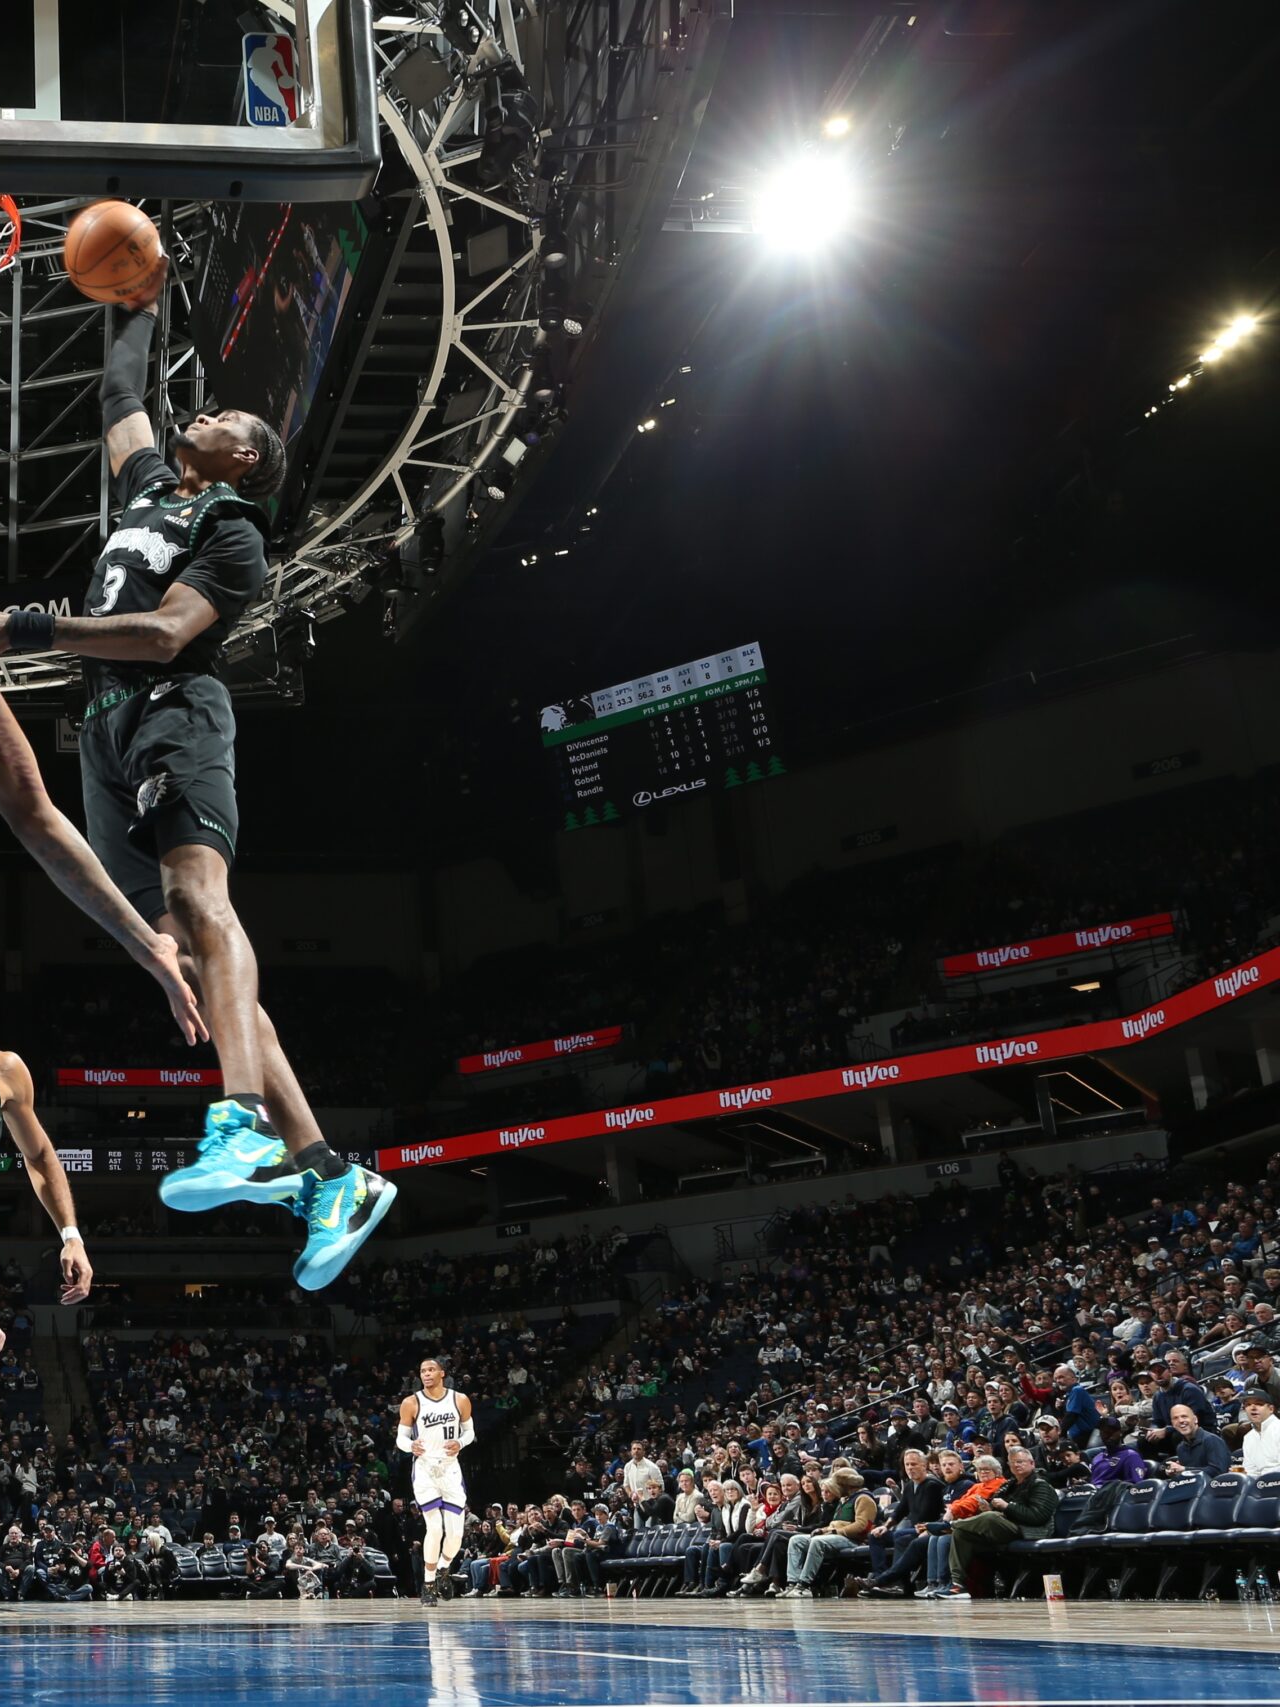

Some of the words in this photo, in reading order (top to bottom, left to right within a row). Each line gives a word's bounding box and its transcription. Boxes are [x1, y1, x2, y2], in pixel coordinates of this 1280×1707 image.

[254, 105, 280, 122] NBA
[163, 514, 189, 528] sezzle
[90, 563, 128, 617] 3
[657, 675, 669, 683] REB
[678, 668, 691, 677] AST
[700, 662, 710, 670] TO
[721, 655, 733, 664] STL
[742, 648, 755, 657] BLK
[598, 702, 613, 713] 41.2
[617, 696, 633, 707] 33.3
[638, 690, 654, 700] 56.2
[661, 685, 672, 694] 26
[682, 678, 692, 687] 14
[643, 707, 655, 716] PTS
[658, 702, 670, 711] REB
[673, 697, 686, 707] AST
[689, 693, 699, 702] PF
[734, 675, 760, 688] 3PM/A
[566, 735, 609, 752] DiVincenzo
[746, 689, 759, 699] 1/5
[569, 746, 609, 763] McDaniels
[748, 701, 762, 711] 1/4
[571, 761, 599, 775] Hyland
[752, 713, 765, 723] 1/3
[574, 773, 601, 786] Gobert
[670, 750, 680, 759] 10
[753, 725, 768, 736] 0/0
[577, 785, 604, 798] Randle
[757, 737, 771, 748] 1/3
[1151, 756, 1182, 777] 206
[652, 778, 707, 800] LEXUS
[976, 945, 1031, 967] HyVee
[1075, 925, 1132, 947] HyVee
[401, 1144, 443, 1164] HyVee
[499, 1127, 545, 1147] HyVee
[605, 1108, 655, 1128] HyVee
[719, 1087, 772, 1109] HyVee
[842, 1064, 899, 1088] HyVee
[975, 1040, 1039, 1064] HyVee
[1121, 1009, 1165, 1039] HyVee
[1214, 965, 1260, 998] HyVee
[483, 1050, 522, 1067] HyVee
[84, 1070, 126, 1085] HyVee
[160, 1070, 201, 1085] HyVee
[58, 1152, 92, 1160] RAMENTO
[61, 1160, 94, 1172] NGS
[347, 1152, 360, 1161] 82
[365, 1157, 372, 1166] 4
[936, 1162, 960, 1175] 106
[505, 1225, 521, 1235] 104
[421, 1412, 456, 1428] Kings
[442, 1426, 455, 1440] 18
